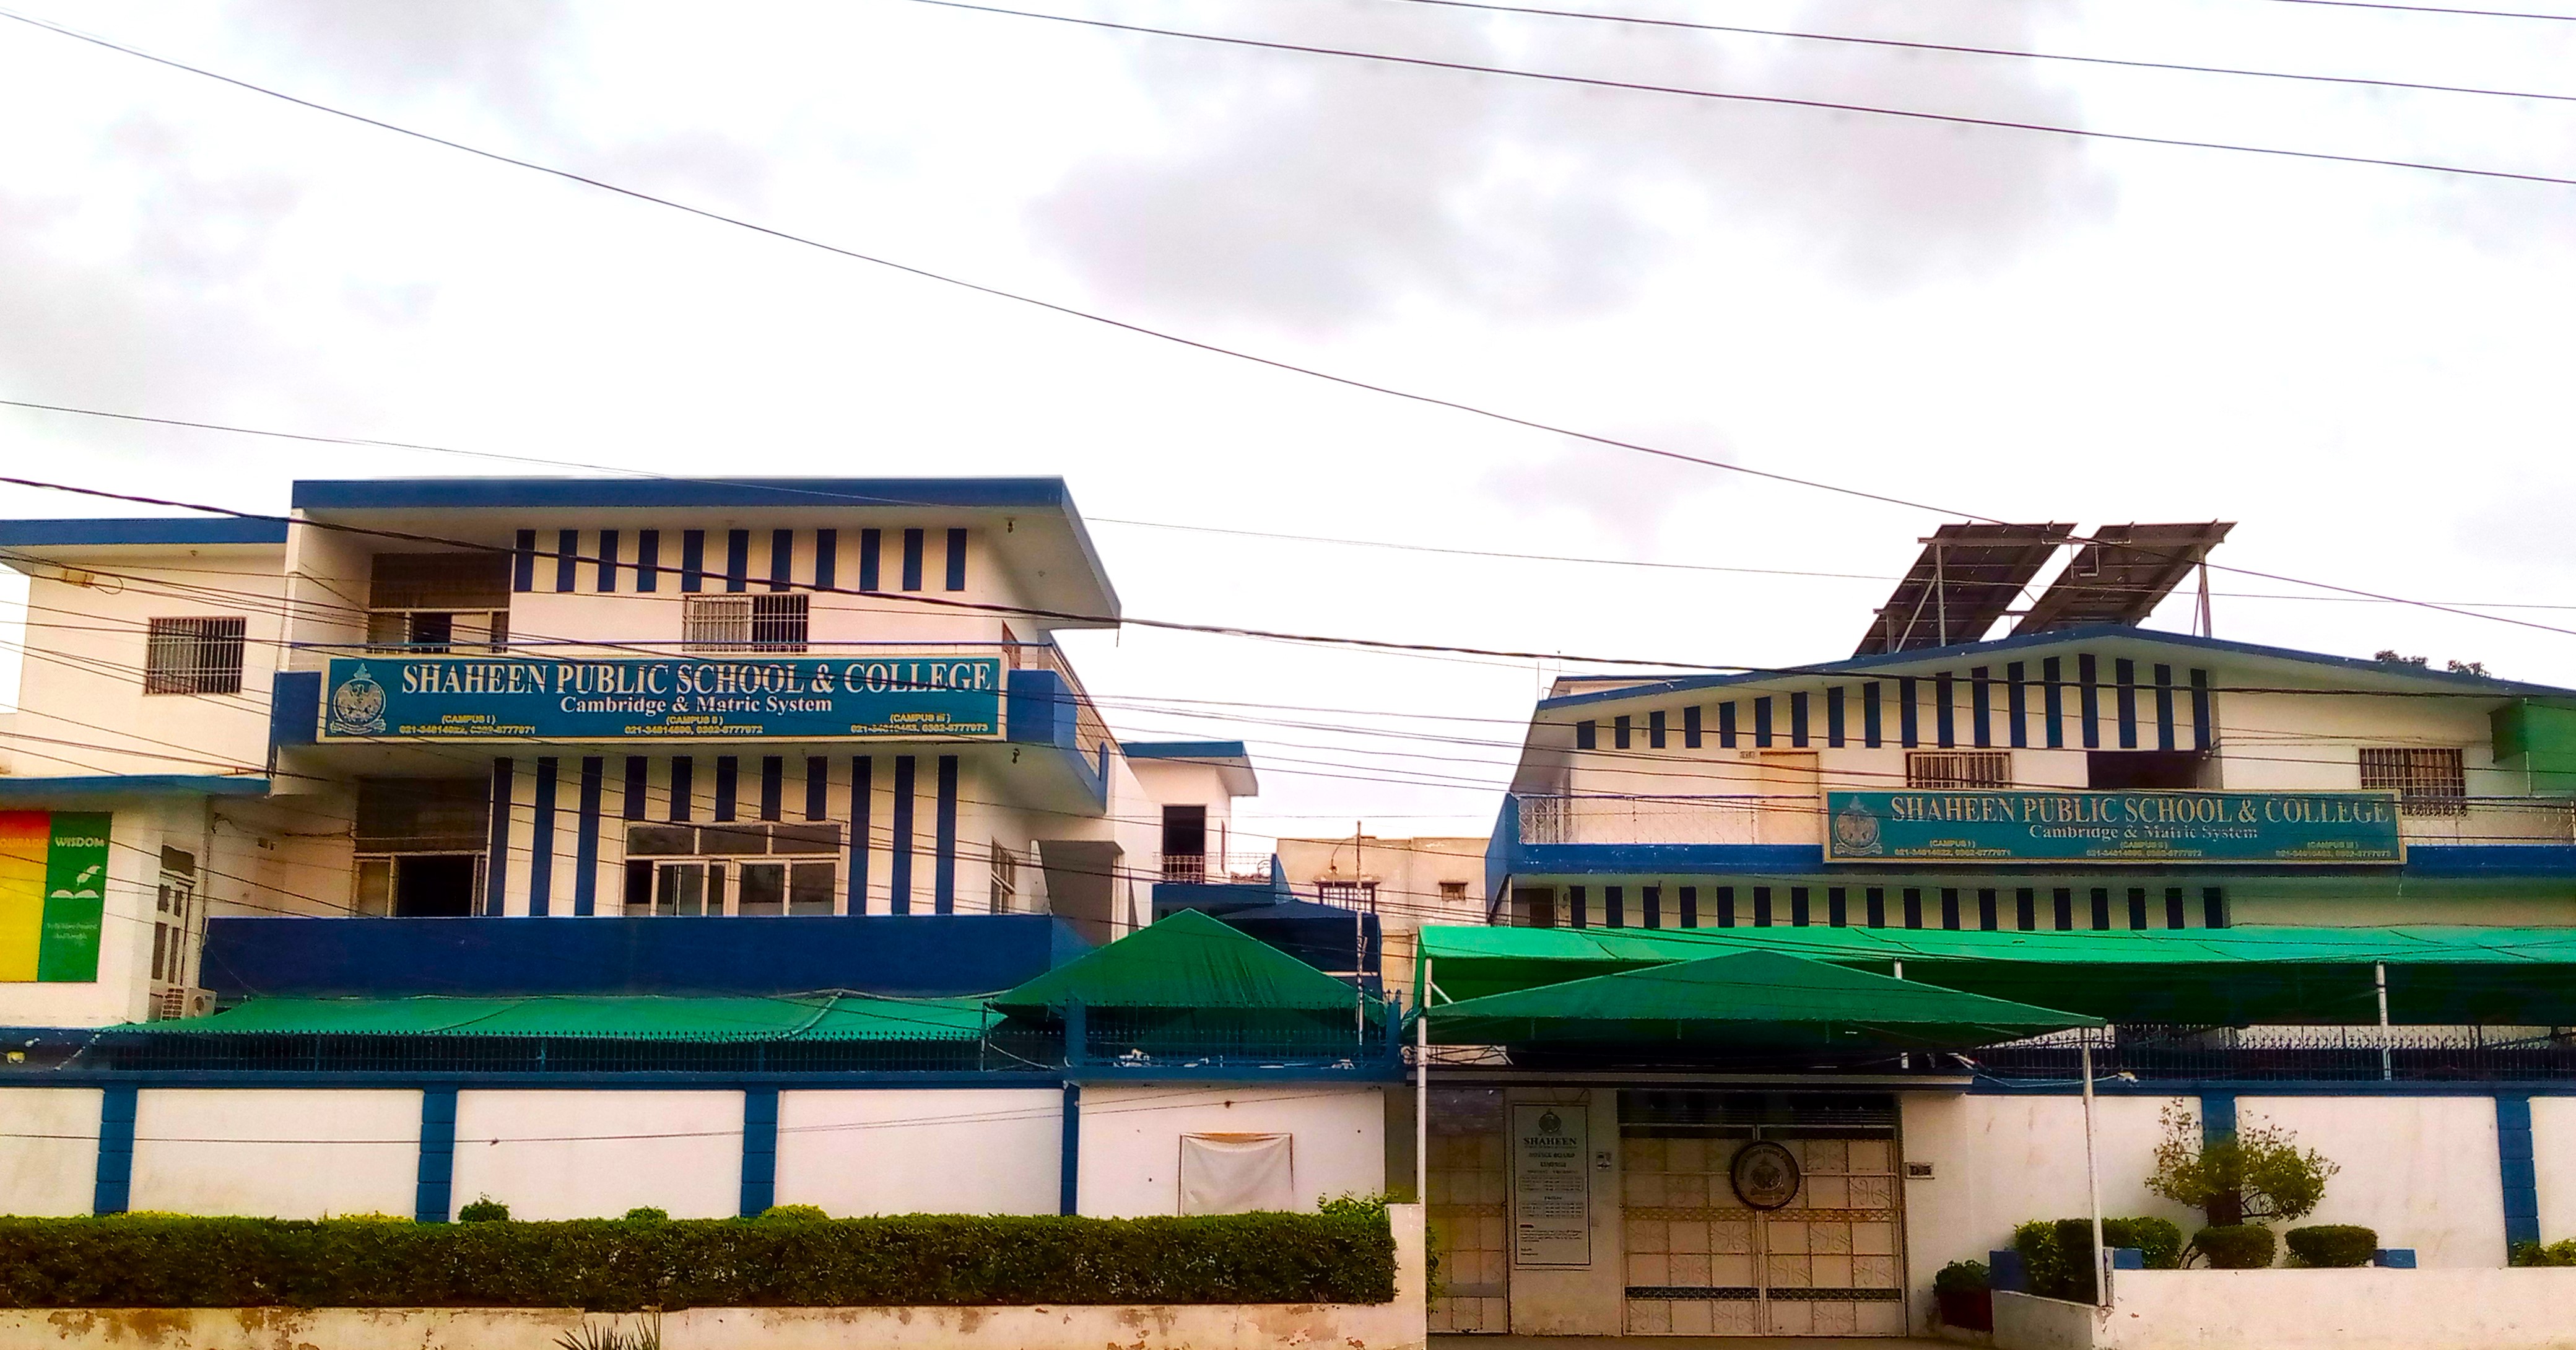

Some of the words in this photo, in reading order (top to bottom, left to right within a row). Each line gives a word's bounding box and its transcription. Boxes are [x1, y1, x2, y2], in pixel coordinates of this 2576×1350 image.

[402, 664, 549, 694] SHAHEEN
[555, 664, 669, 695] PUBLIC
[676, 663, 804, 695] SCHOOL
[811, 663, 835, 694] &
[843, 662, 991, 694] COLLEGE
[560, 695, 667, 717] Cambridge
[671, 695, 690, 713] &
[697, 695, 760, 712] Matric
[766, 695, 833, 716] System
[1891, 796, 2015, 822] SHAHEEN
[2022, 797, 2117, 822] PUBLIC
[2124, 797, 2232, 823] SCHOOL
[2238, 799, 2258, 823] &
[2265, 798, 2389, 823] COLLEGE
[54, 836, 106, 847] WISDOM
[2029, 825, 2118, 841] Cambridge
[2123, 824, 2138, 838] &
[2143, 825, 2196, 838] Matric
[2201, 825, 2258, 842] System
[1523, 1137, 1577, 1146] SHAHEEN
